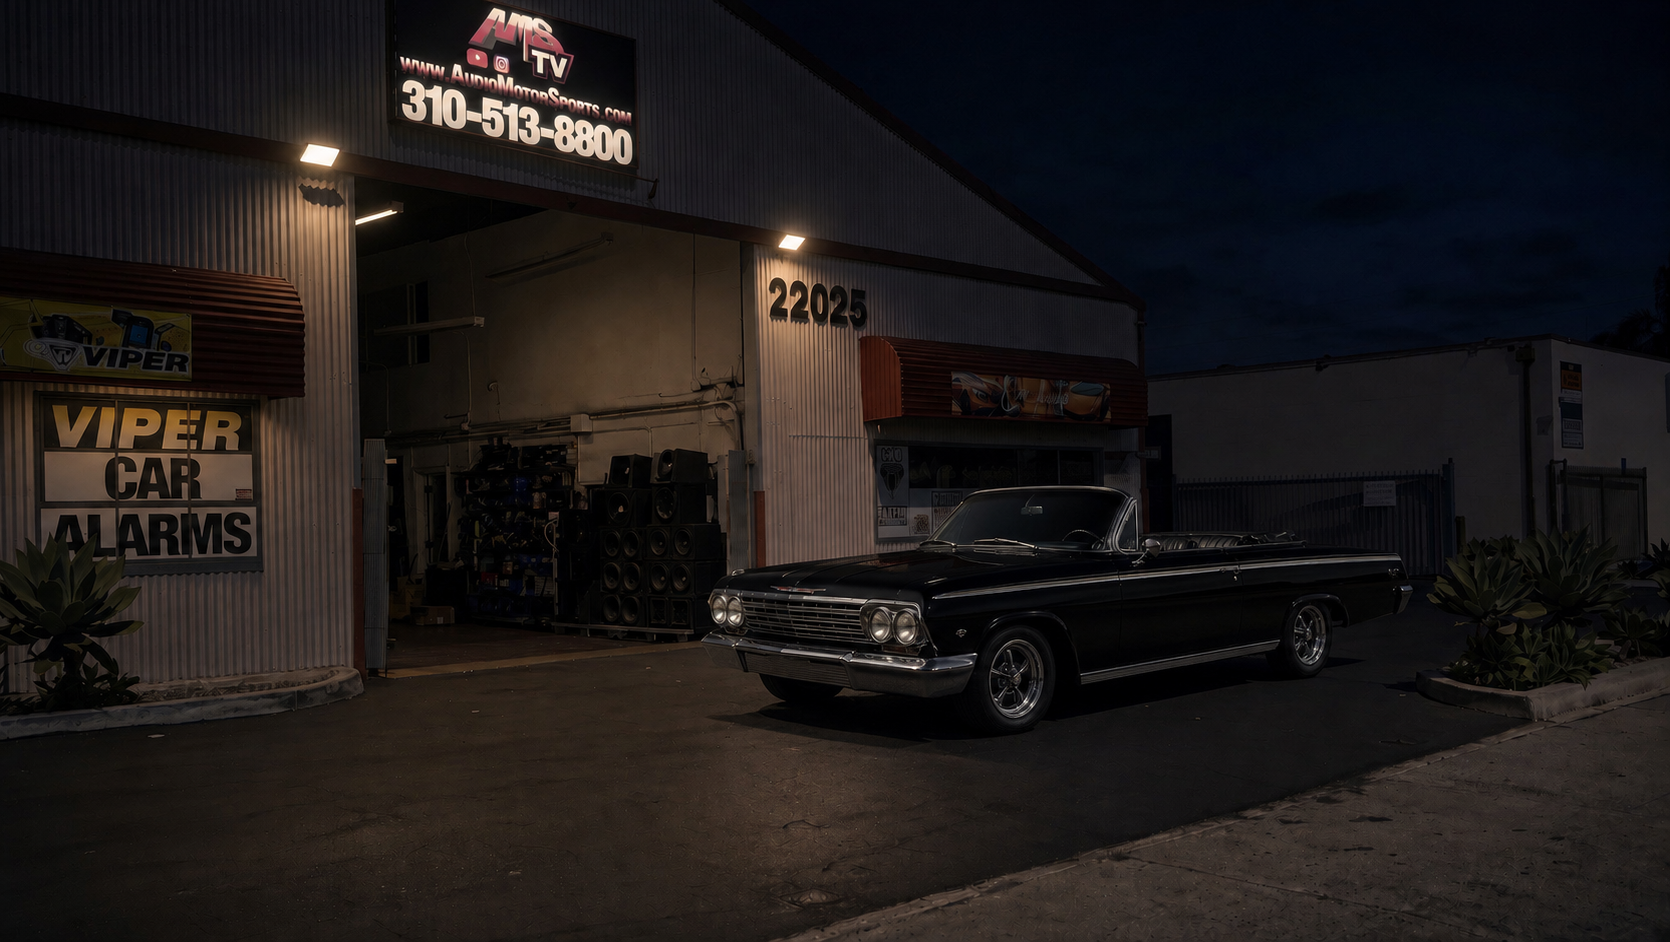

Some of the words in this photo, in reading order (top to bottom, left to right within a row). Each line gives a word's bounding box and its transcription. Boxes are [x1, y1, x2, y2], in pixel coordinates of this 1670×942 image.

[468, 7, 564, 60] AMS
[530, 49, 569, 79] TV
[401, 79, 633, 166] 310-513-8800
[769, 277, 867, 327] 22025
[83, 346, 189, 372] VIPER
[52, 404, 242, 450] VIPER
[105, 456, 202, 500] CAR
[54, 512, 252, 557] ALARMS
